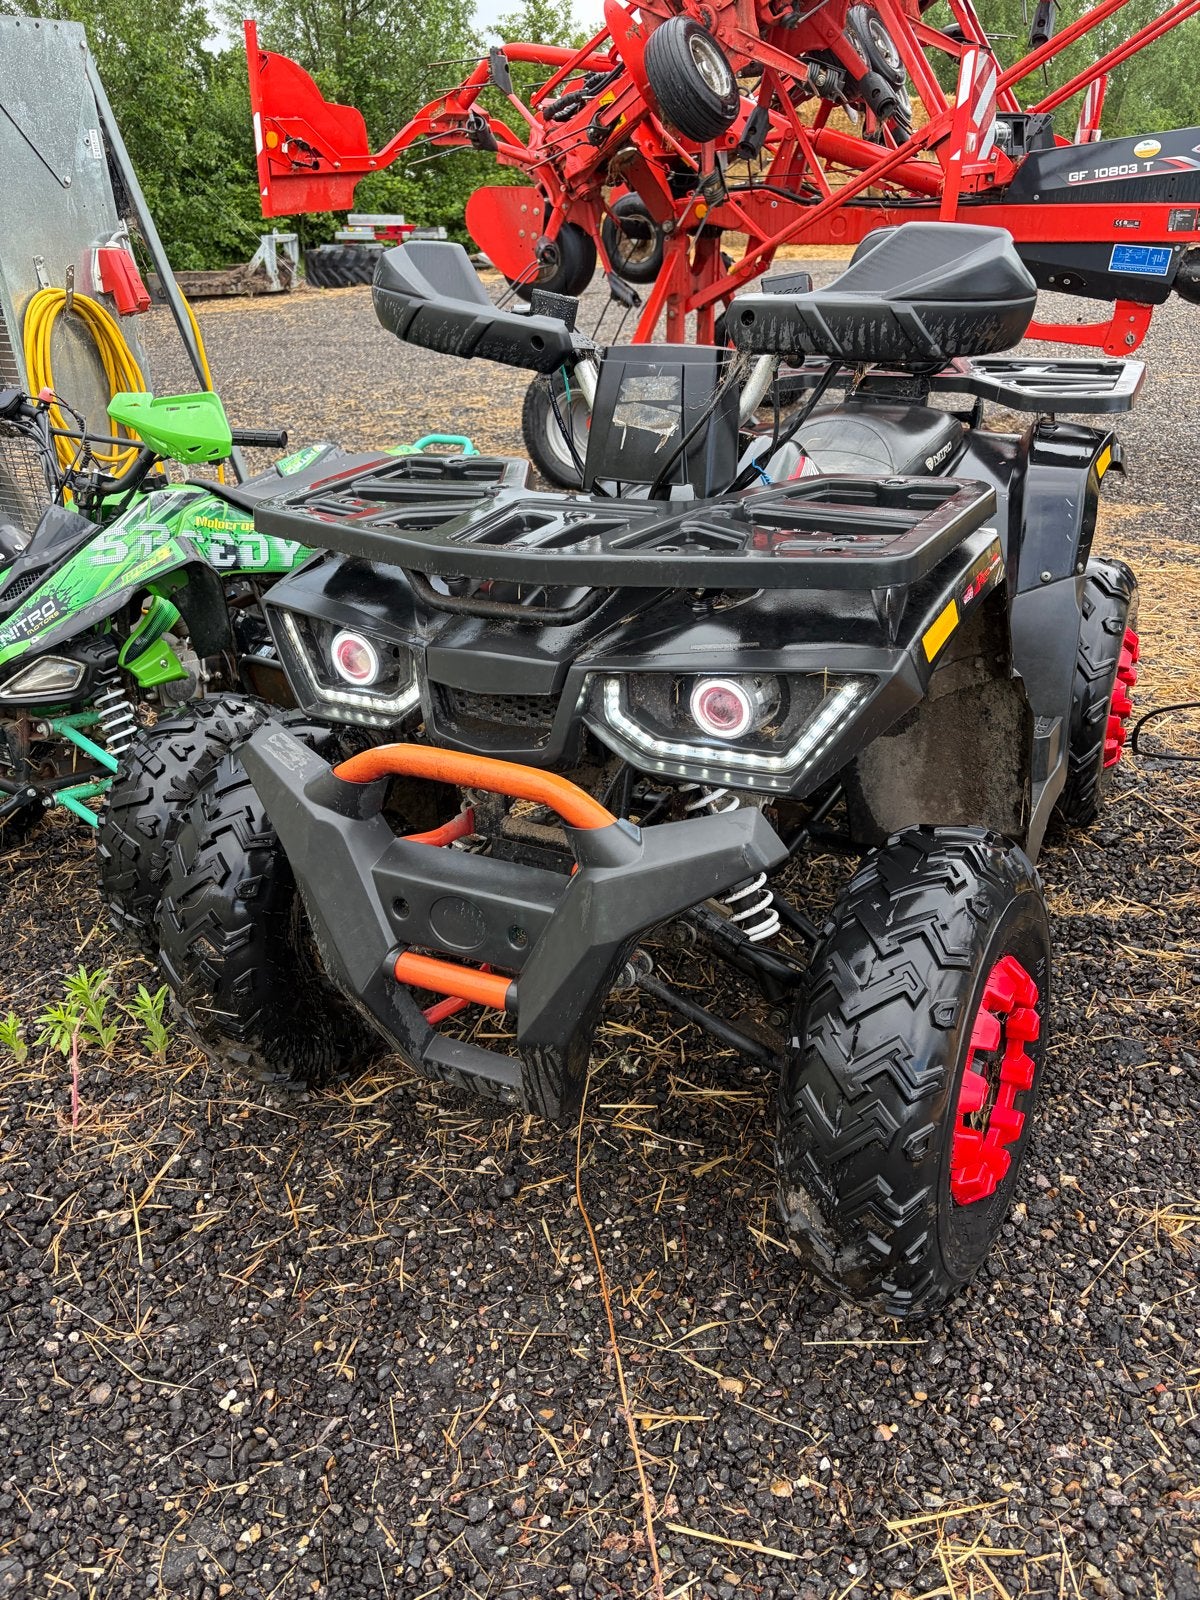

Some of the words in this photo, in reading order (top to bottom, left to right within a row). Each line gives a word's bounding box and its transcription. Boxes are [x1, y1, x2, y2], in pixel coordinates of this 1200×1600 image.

[1068, 170, 1089, 182] GF
[1093, 163, 1138, 179] 10803
[1143, 161, 1154, 172] T
[0, 600, 56, 646] NITRO
[26, 610, 60, 636] MOTORS
